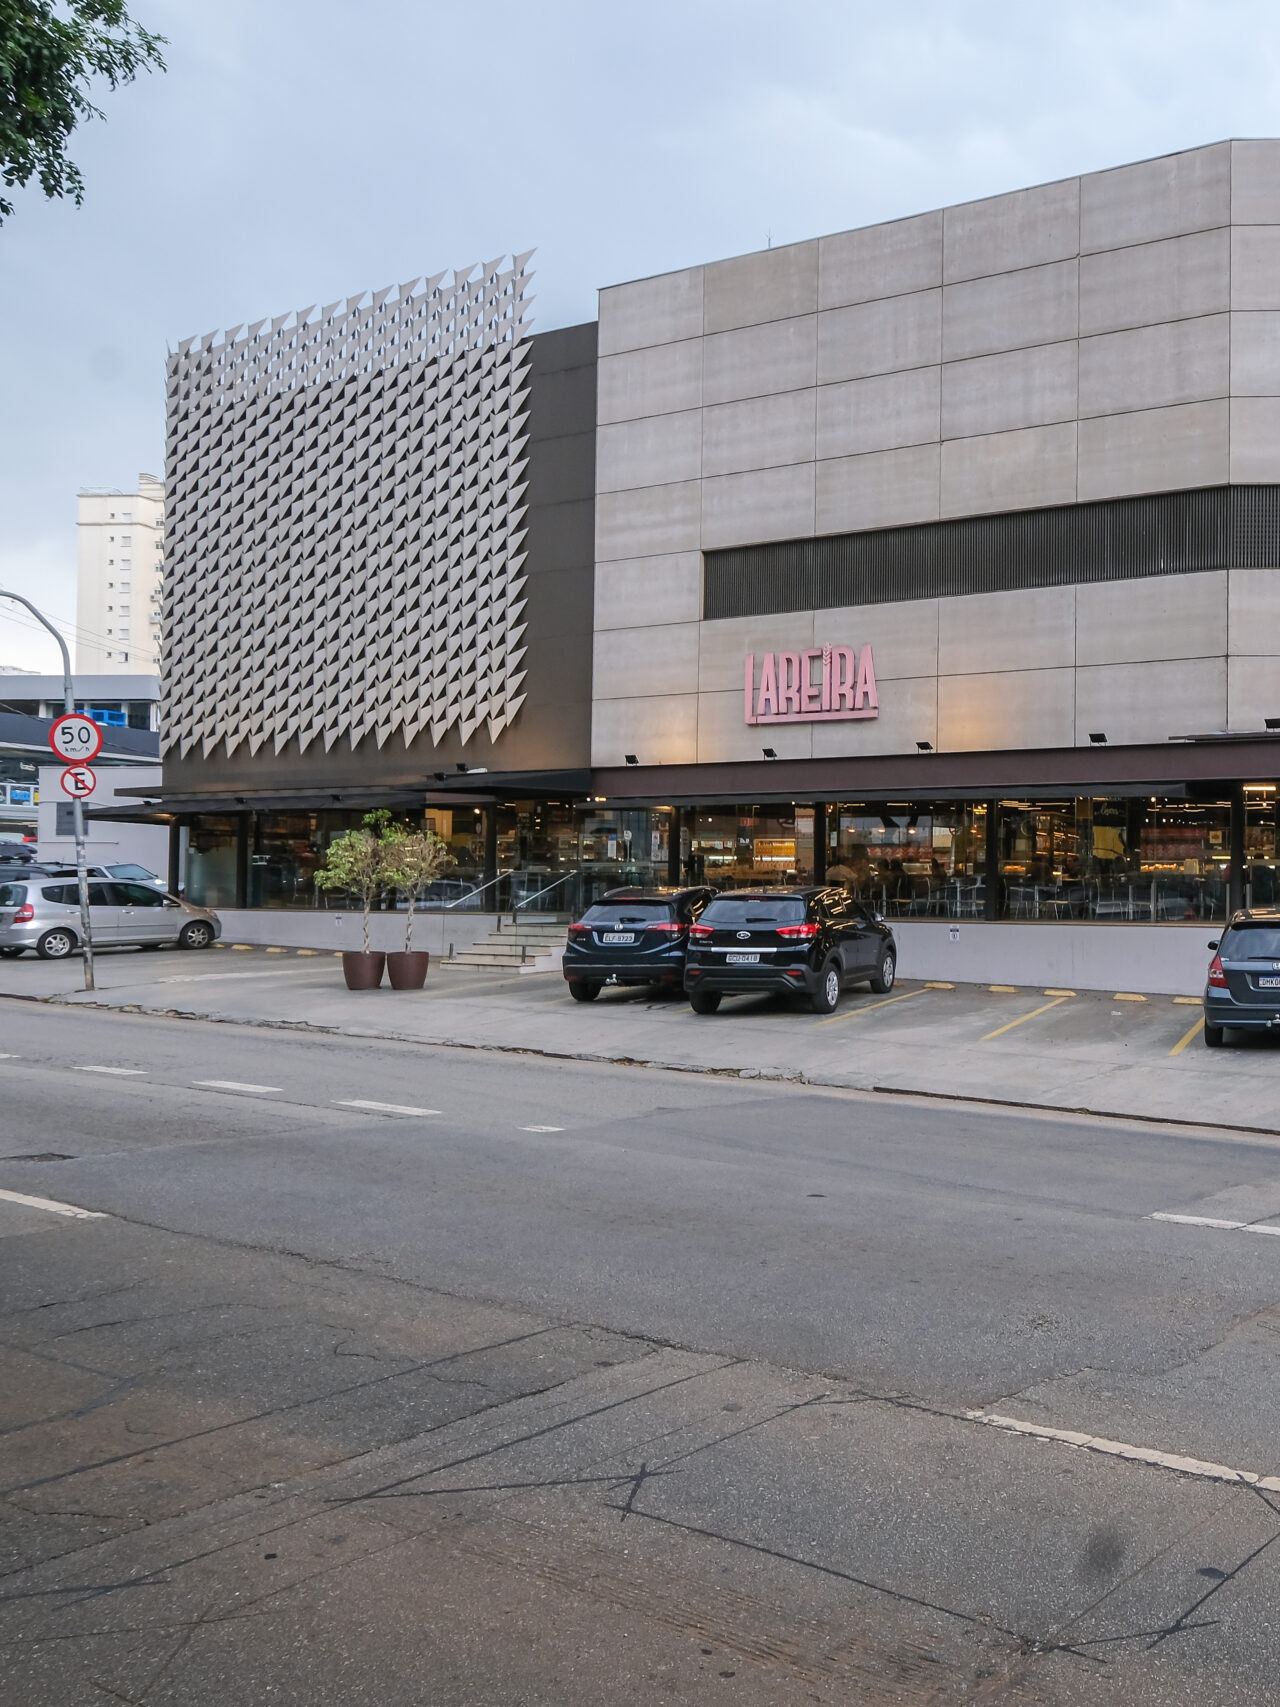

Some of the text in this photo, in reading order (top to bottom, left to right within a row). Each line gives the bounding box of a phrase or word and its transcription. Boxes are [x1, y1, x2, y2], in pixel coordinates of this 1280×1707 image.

[744, 642, 879, 724] LAREIRA
[61, 726, 91, 744] 50
[73, 772, 87, 790] E
